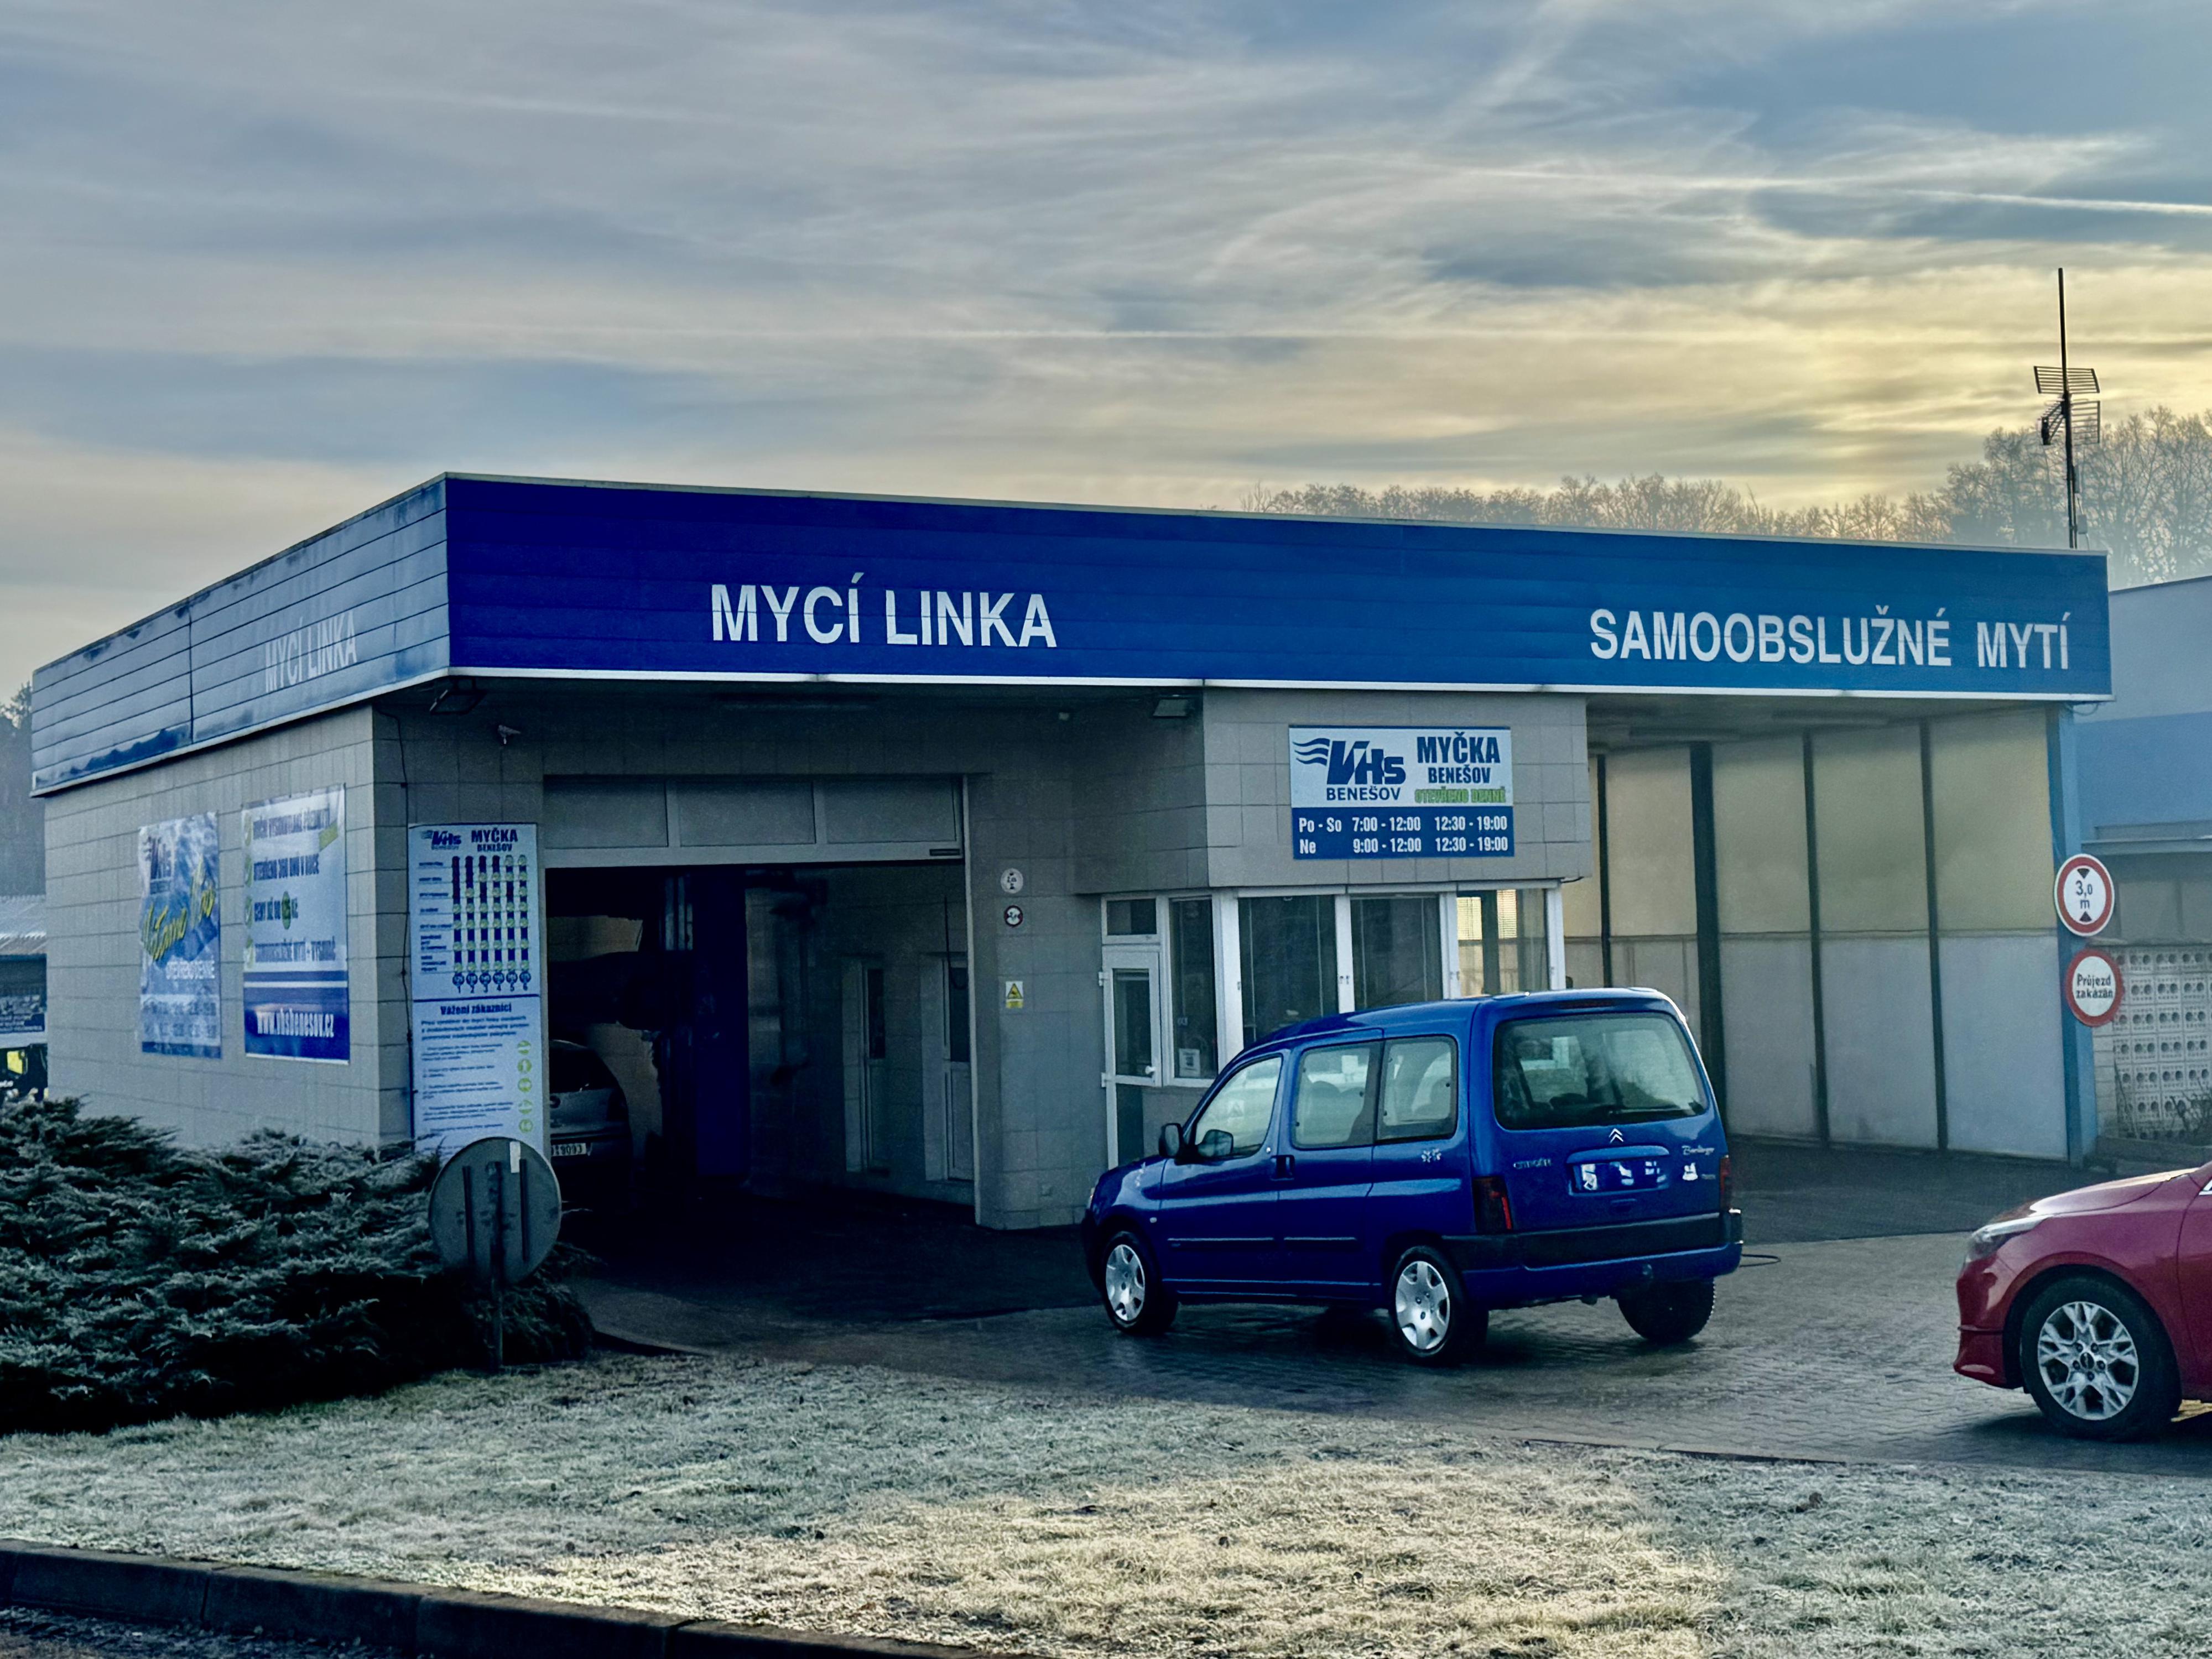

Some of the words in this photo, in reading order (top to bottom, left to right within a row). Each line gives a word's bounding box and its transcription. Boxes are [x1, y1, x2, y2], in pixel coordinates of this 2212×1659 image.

[711, 572, 864, 644] MYCÍ
[886, 589, 1057, 648] LINKA
[1590, 605, 1951, 666] SAMOOBSLUŽNÉ
[1977, 612, 2070, 669] MYTÍ
[265, 616, 303, 693] MYCÍ
[308, 610, 357, 680] LINKA
[1417, 731, 1501, 764] MYČKA
[1428, 764, 1491, 784] BENEŠOV
[1326, 786, 1401, 801] BENEŠOV
[1299, 817, 1315, 832] Po
[1326, 817, 1342, 832] So
[1352, 817, 1378, 832] 7:00
[1389, 816, 1422, 831] 12:00
[1434, 816, 1466, 831] 12:30
[1477, 815, 1507, 831] 19:00
[471, 827, 518, 843] MYČKA
[1299, 839, 1316, 853] Ne
[1353, 838, 1378, 853] 9:00
[1389, 838, 1422, 853] 12:00
[1435, 837, 1466, 852] 12:30
[1477, 836, 1508, 852] 19:00
[2076, 880, 2093, 898] 3,0
[2080, 898, 2090, 909] m
[2076, 973, 2111, 988] Průjezd
[2076, 987, 2114, 999] zakázán
